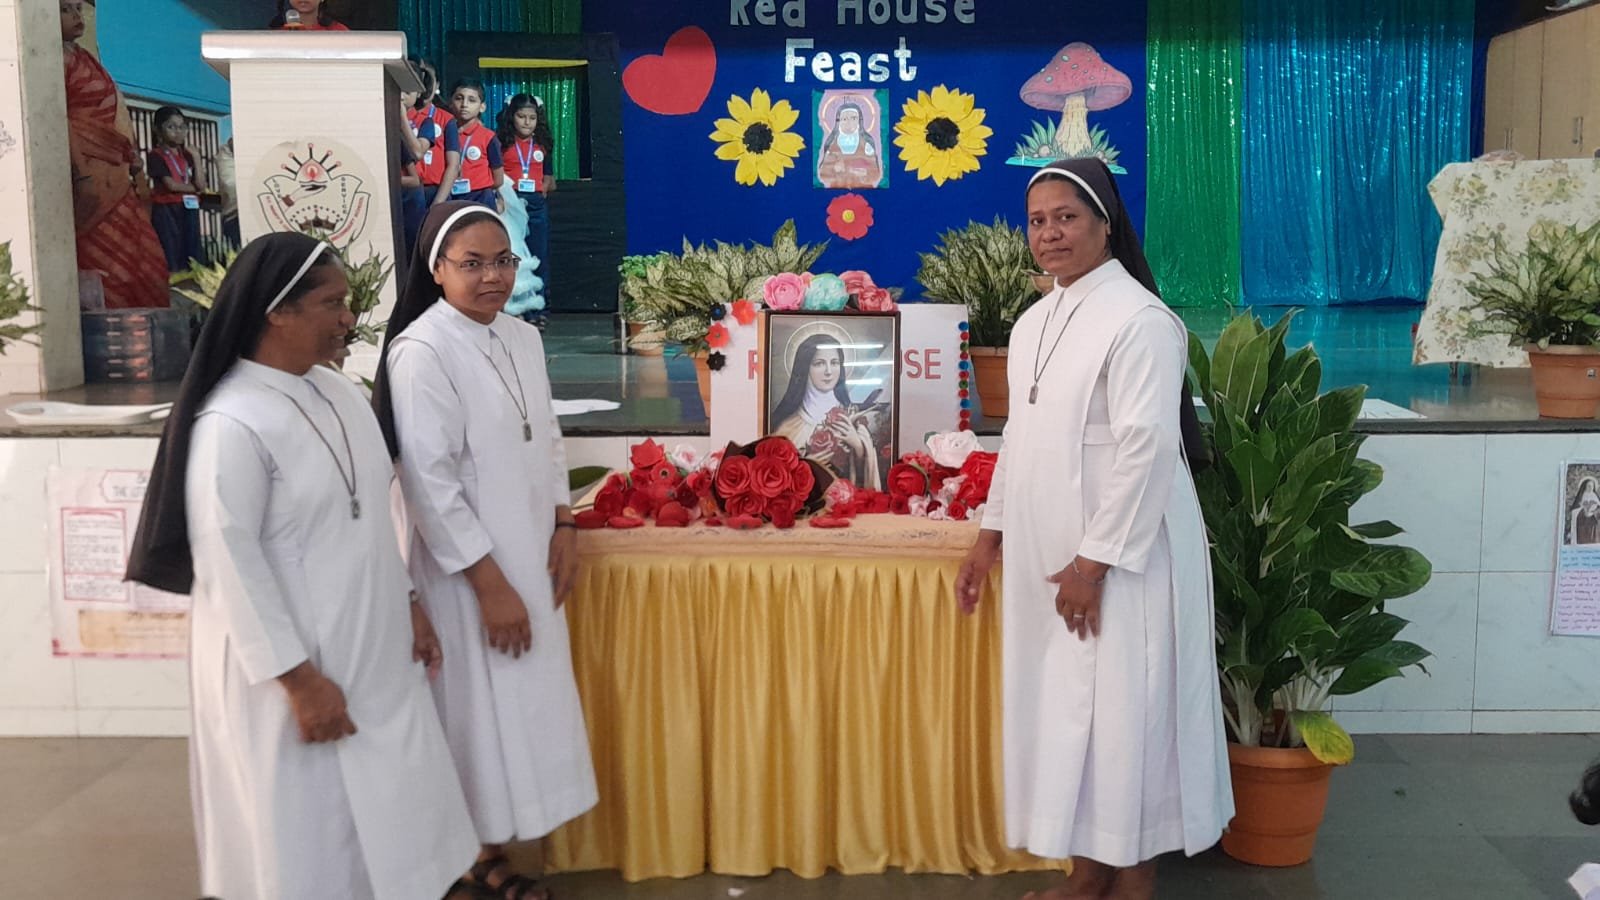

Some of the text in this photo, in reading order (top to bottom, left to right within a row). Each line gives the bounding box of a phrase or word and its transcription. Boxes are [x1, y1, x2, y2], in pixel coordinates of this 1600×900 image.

[730, 0, 976, 28] Red House
[784, 37, 917, 83] Feast
